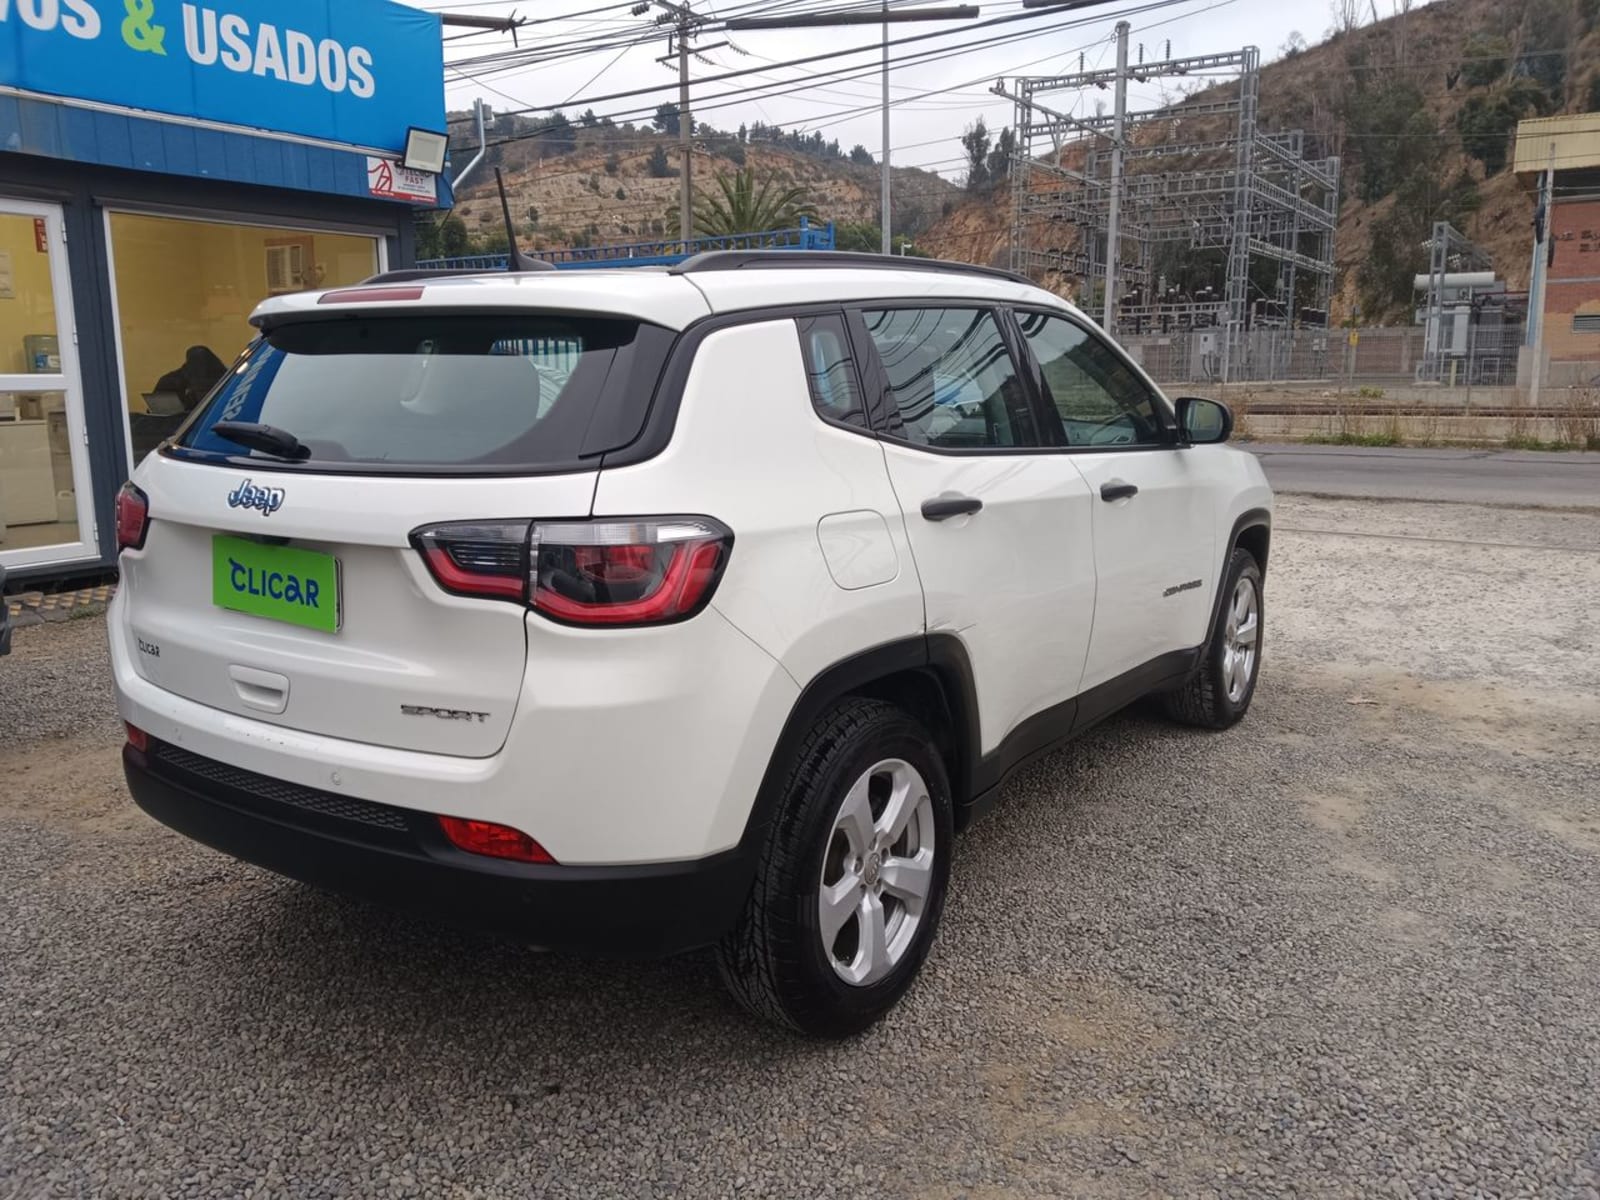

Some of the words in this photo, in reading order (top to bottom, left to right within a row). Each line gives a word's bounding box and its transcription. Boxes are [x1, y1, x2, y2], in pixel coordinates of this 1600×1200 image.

[121, 0, 167, 56] &
[183, 3, 376, 98] USADOS
[405, 175, 424, 185] FAST
[228, 479, 285, 516] Jeep
[400, 704, 490, 723] SPORT
